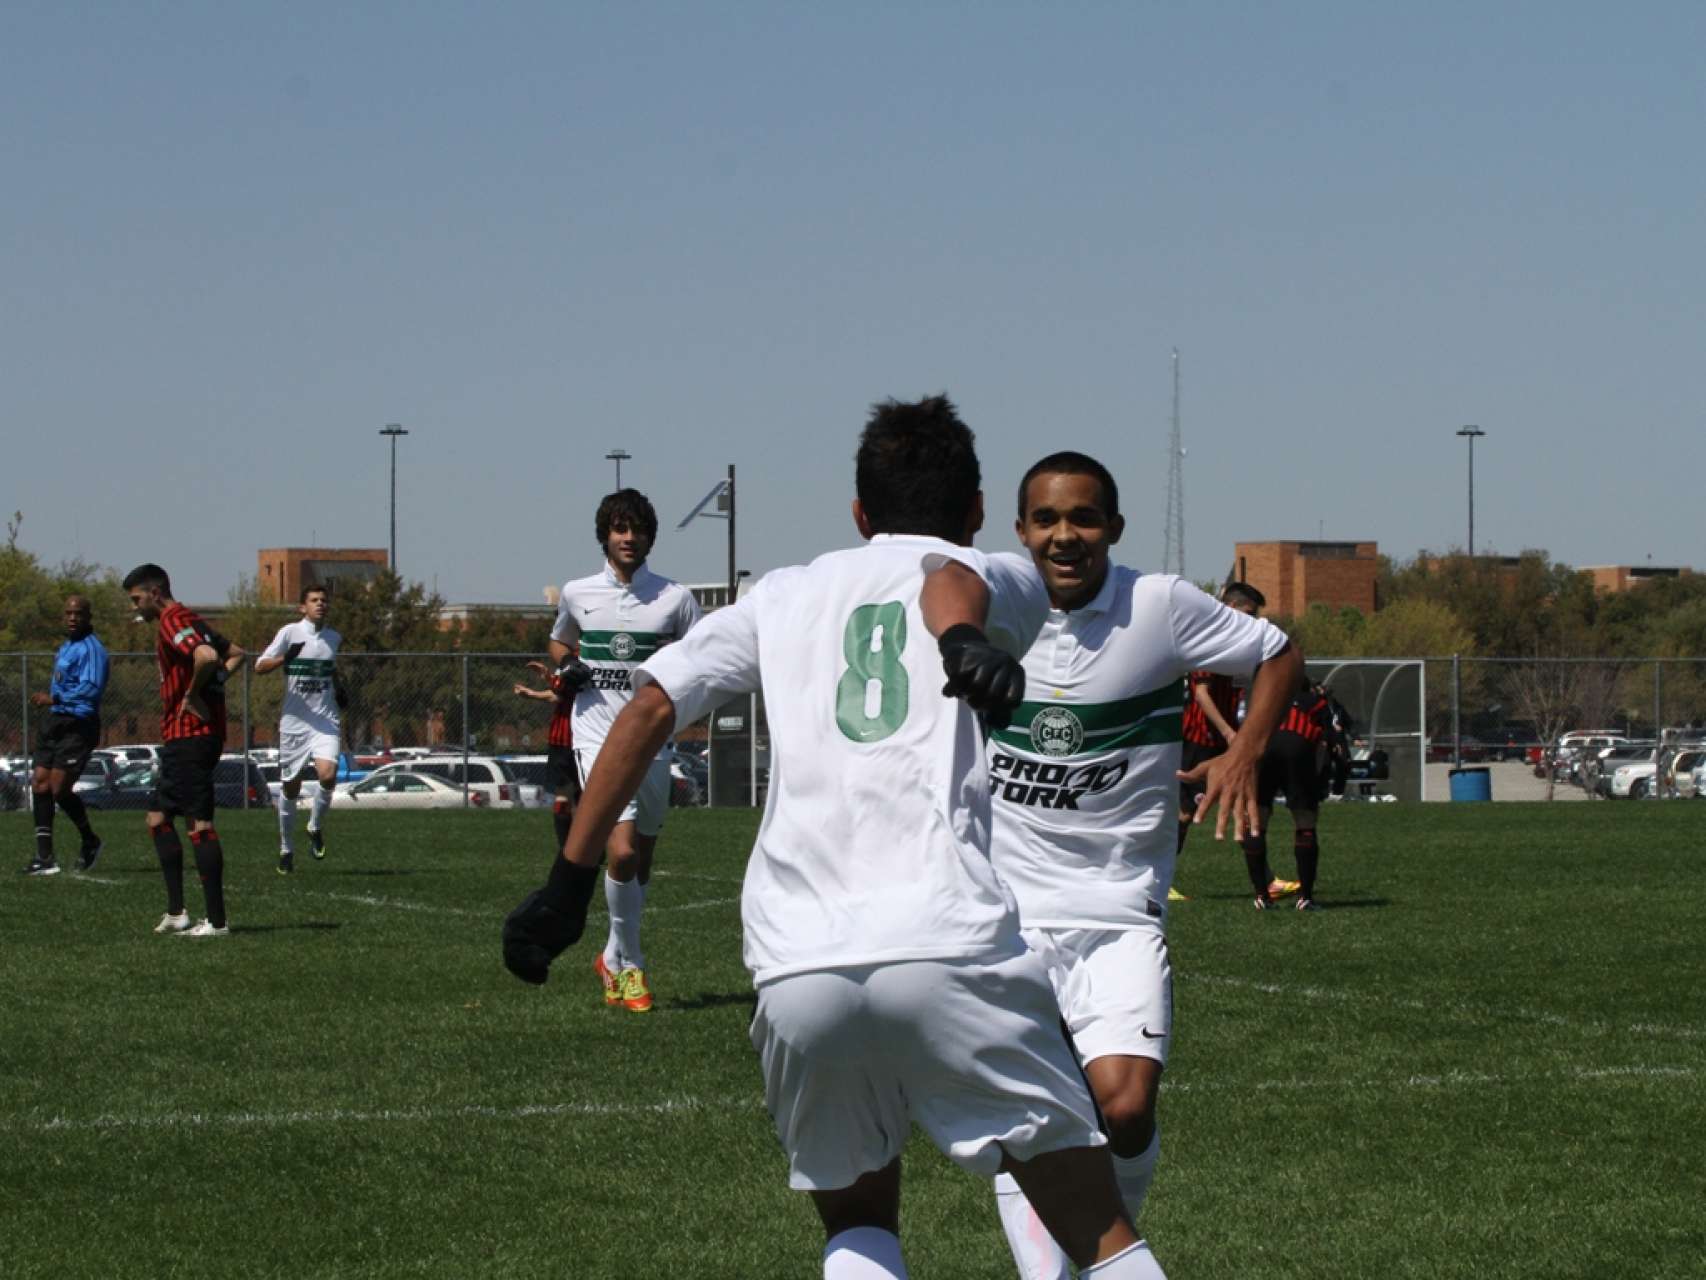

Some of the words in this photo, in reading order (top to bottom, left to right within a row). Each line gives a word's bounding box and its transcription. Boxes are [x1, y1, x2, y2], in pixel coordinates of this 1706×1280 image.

[592, 667, 628, 679] PRO
[836, 600, 908, 742] 8
[1042, 726, 1072, 741] CFC
[990, 754, 1068, 785] PRO
[990, 775, 1088, 810] TORK
